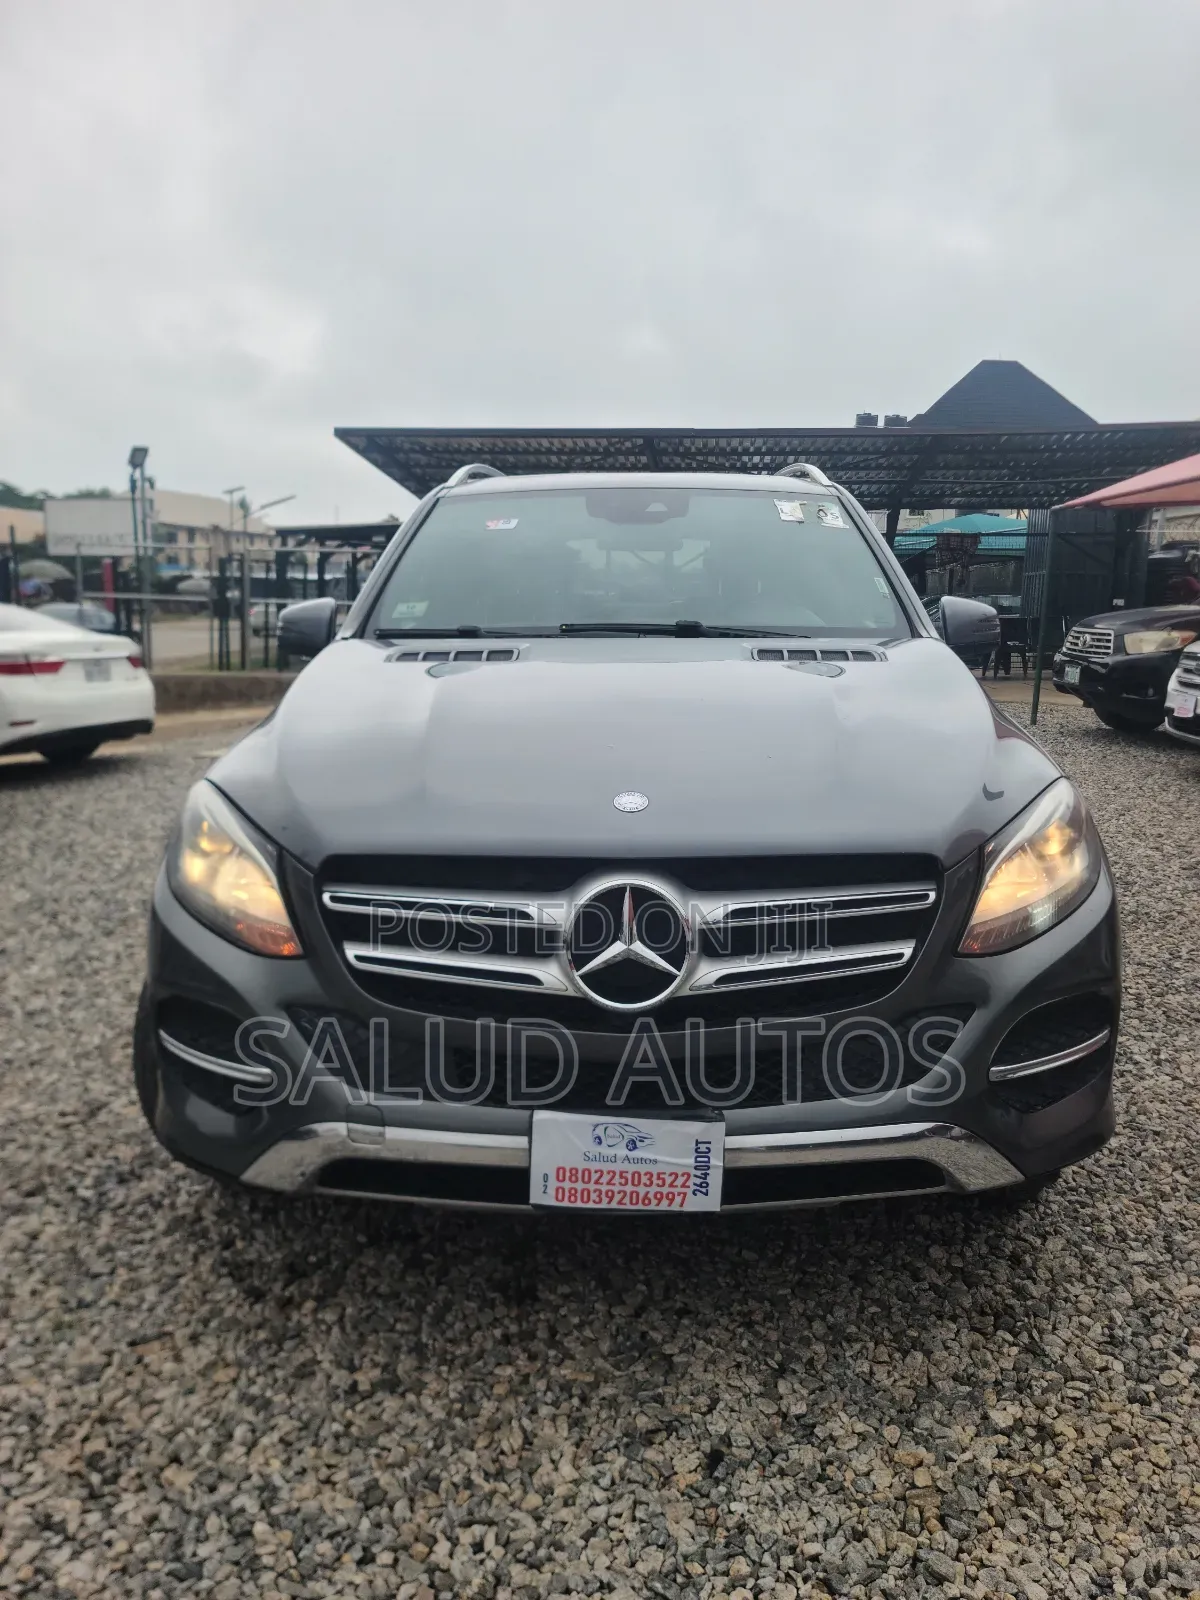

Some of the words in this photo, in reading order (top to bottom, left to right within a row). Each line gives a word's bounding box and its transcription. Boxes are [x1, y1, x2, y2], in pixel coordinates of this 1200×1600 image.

[583, 1151, 617, 1164] Salud
[621, 1154, 658, 1165] Autos
[692, 1139, 712, 1197] 2640DCT
[555, 1166, 691, 1189] 08022503522
[554, 1186, 688, 1208] 08039206997
